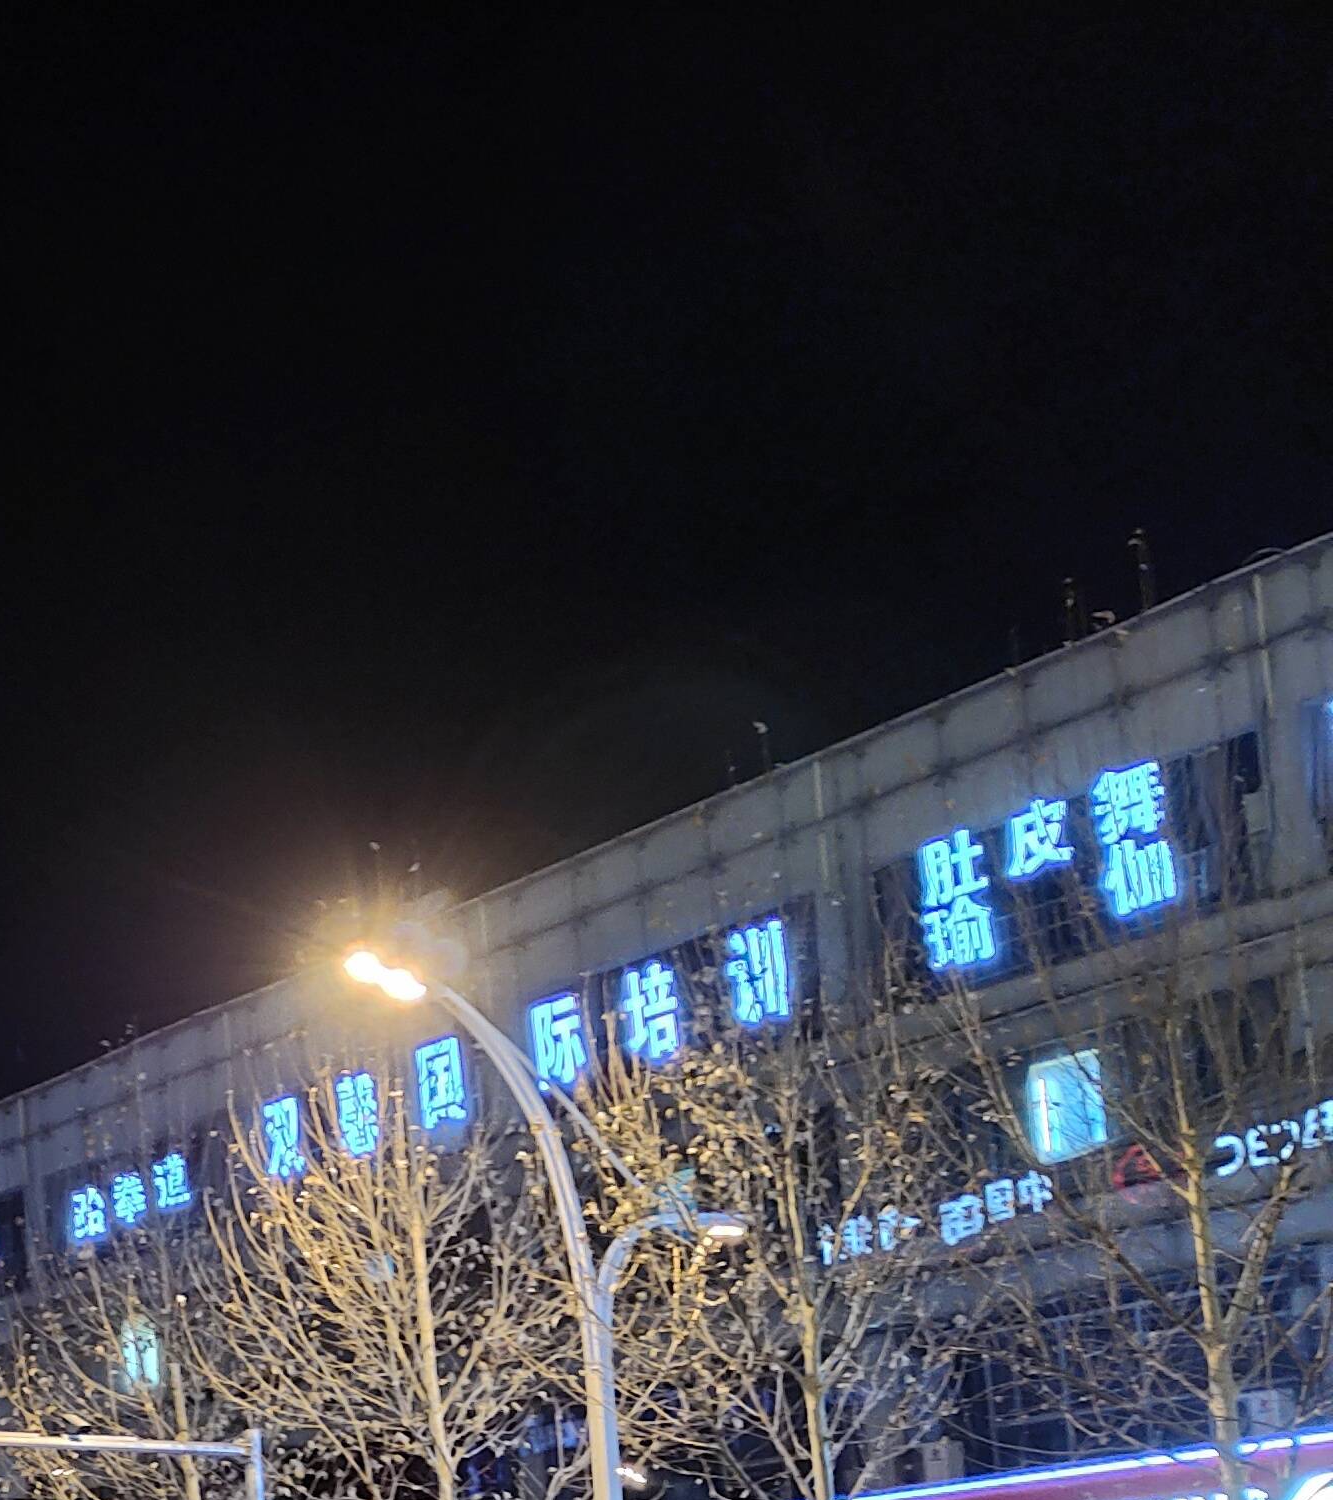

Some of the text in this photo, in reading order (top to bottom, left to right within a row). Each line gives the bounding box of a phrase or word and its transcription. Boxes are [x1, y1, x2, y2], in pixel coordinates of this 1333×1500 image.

[921, 761, 1165, 908] 肚皮舞
[72, 1153, 192, 1239] 跆拳道
